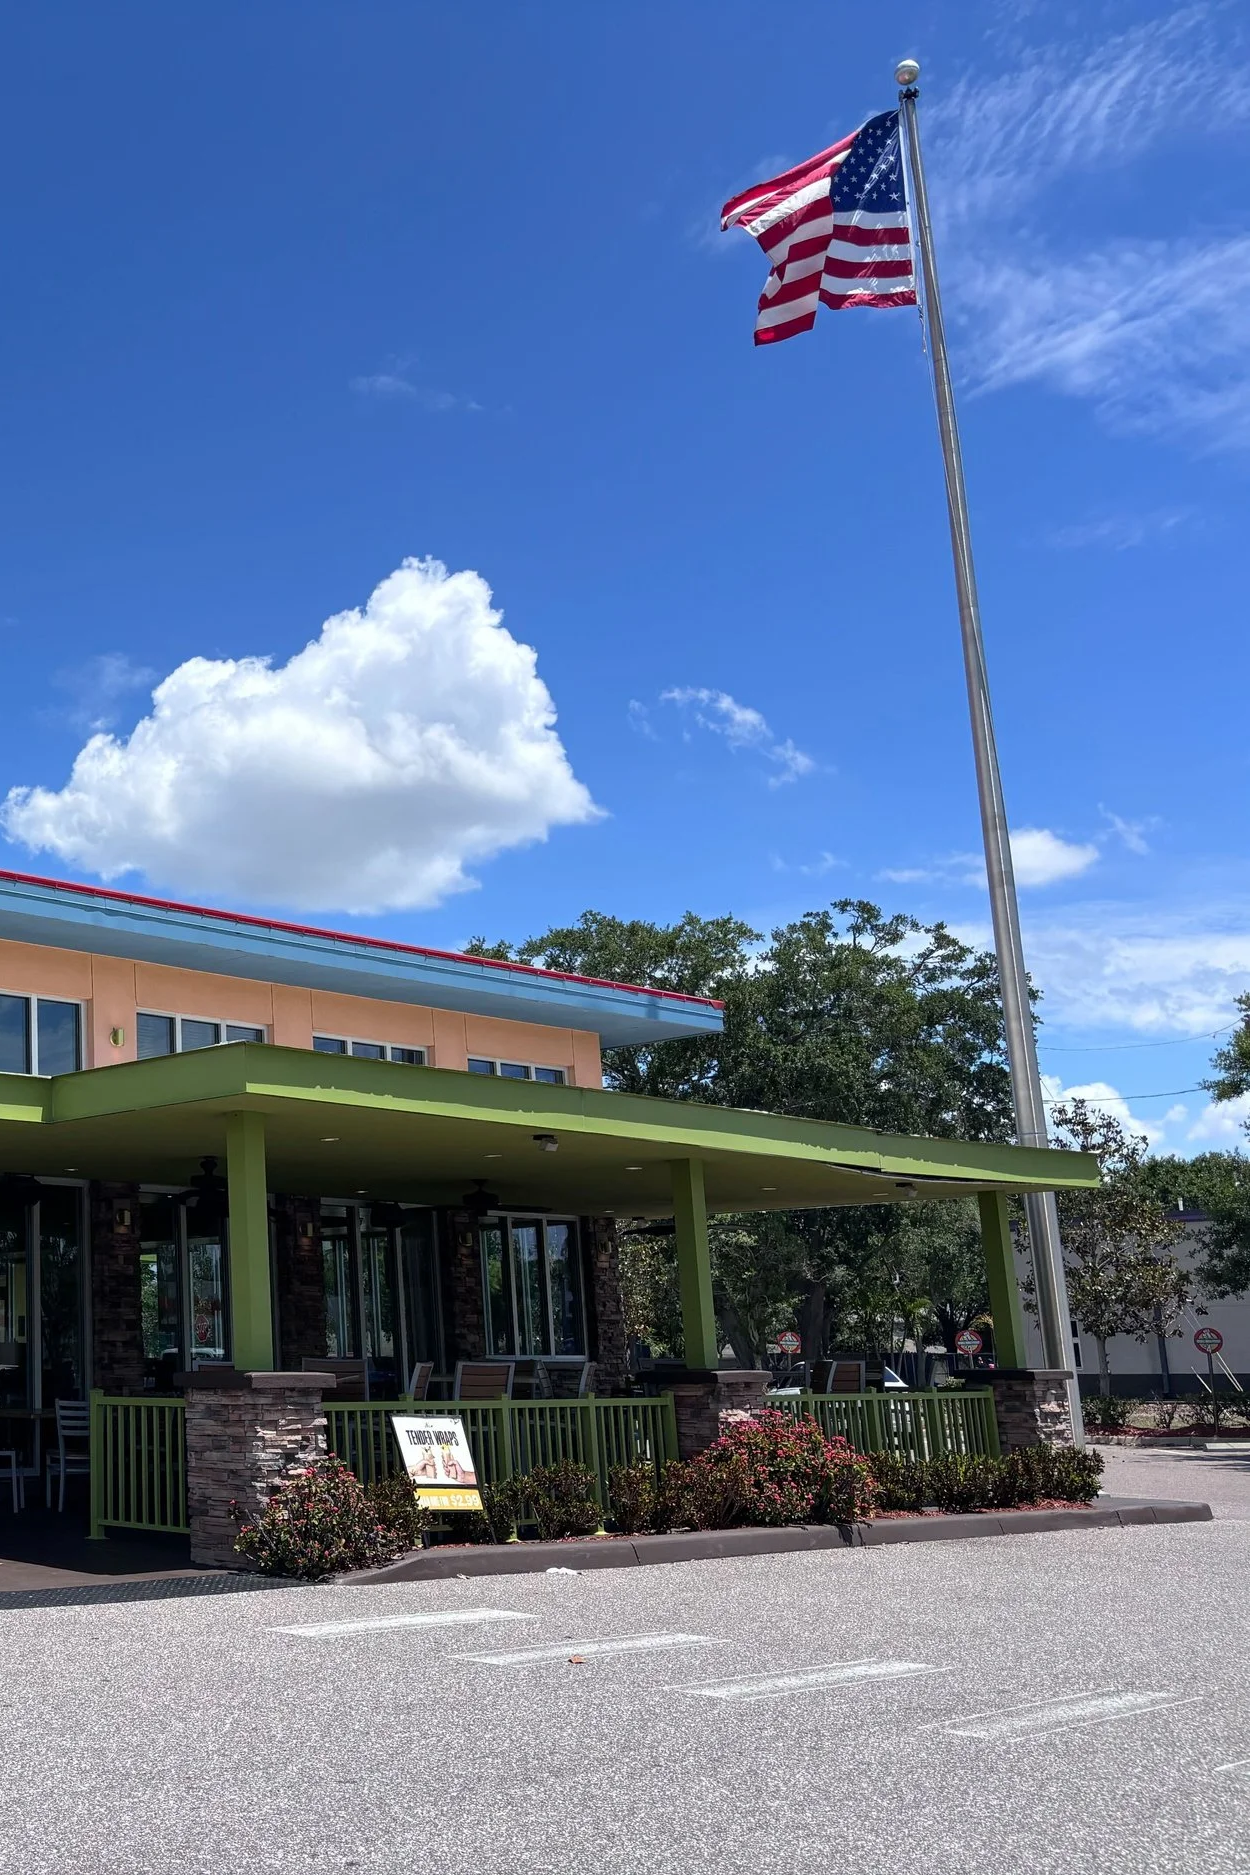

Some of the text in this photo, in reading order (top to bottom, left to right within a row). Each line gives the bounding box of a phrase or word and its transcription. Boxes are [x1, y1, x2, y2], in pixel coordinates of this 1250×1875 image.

[406, 1430, 459, 1447] TENDER WRAPS
[451, 1494, 478, 1507] $2.99
